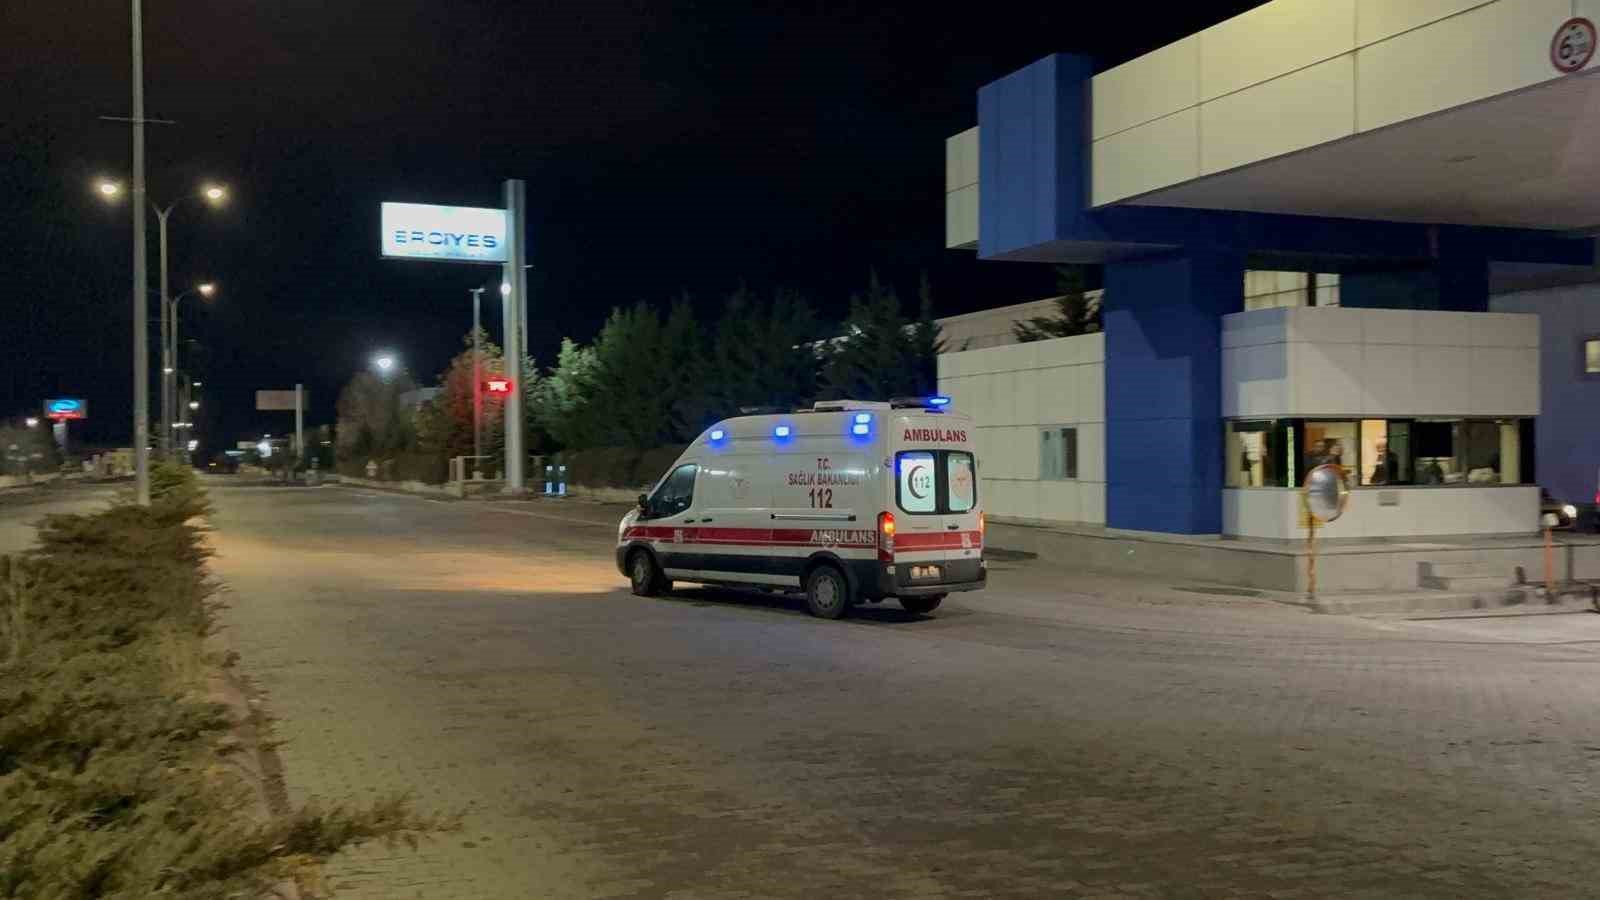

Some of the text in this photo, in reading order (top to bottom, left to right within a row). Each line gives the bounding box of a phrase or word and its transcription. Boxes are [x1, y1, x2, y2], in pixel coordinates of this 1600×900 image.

[903, 428, 967, 442] AMBULANS
[914, 475, 931, 489] 112
[808, 488, 833, 508] 112
[811, 529, 876, 545] AMBULANS
